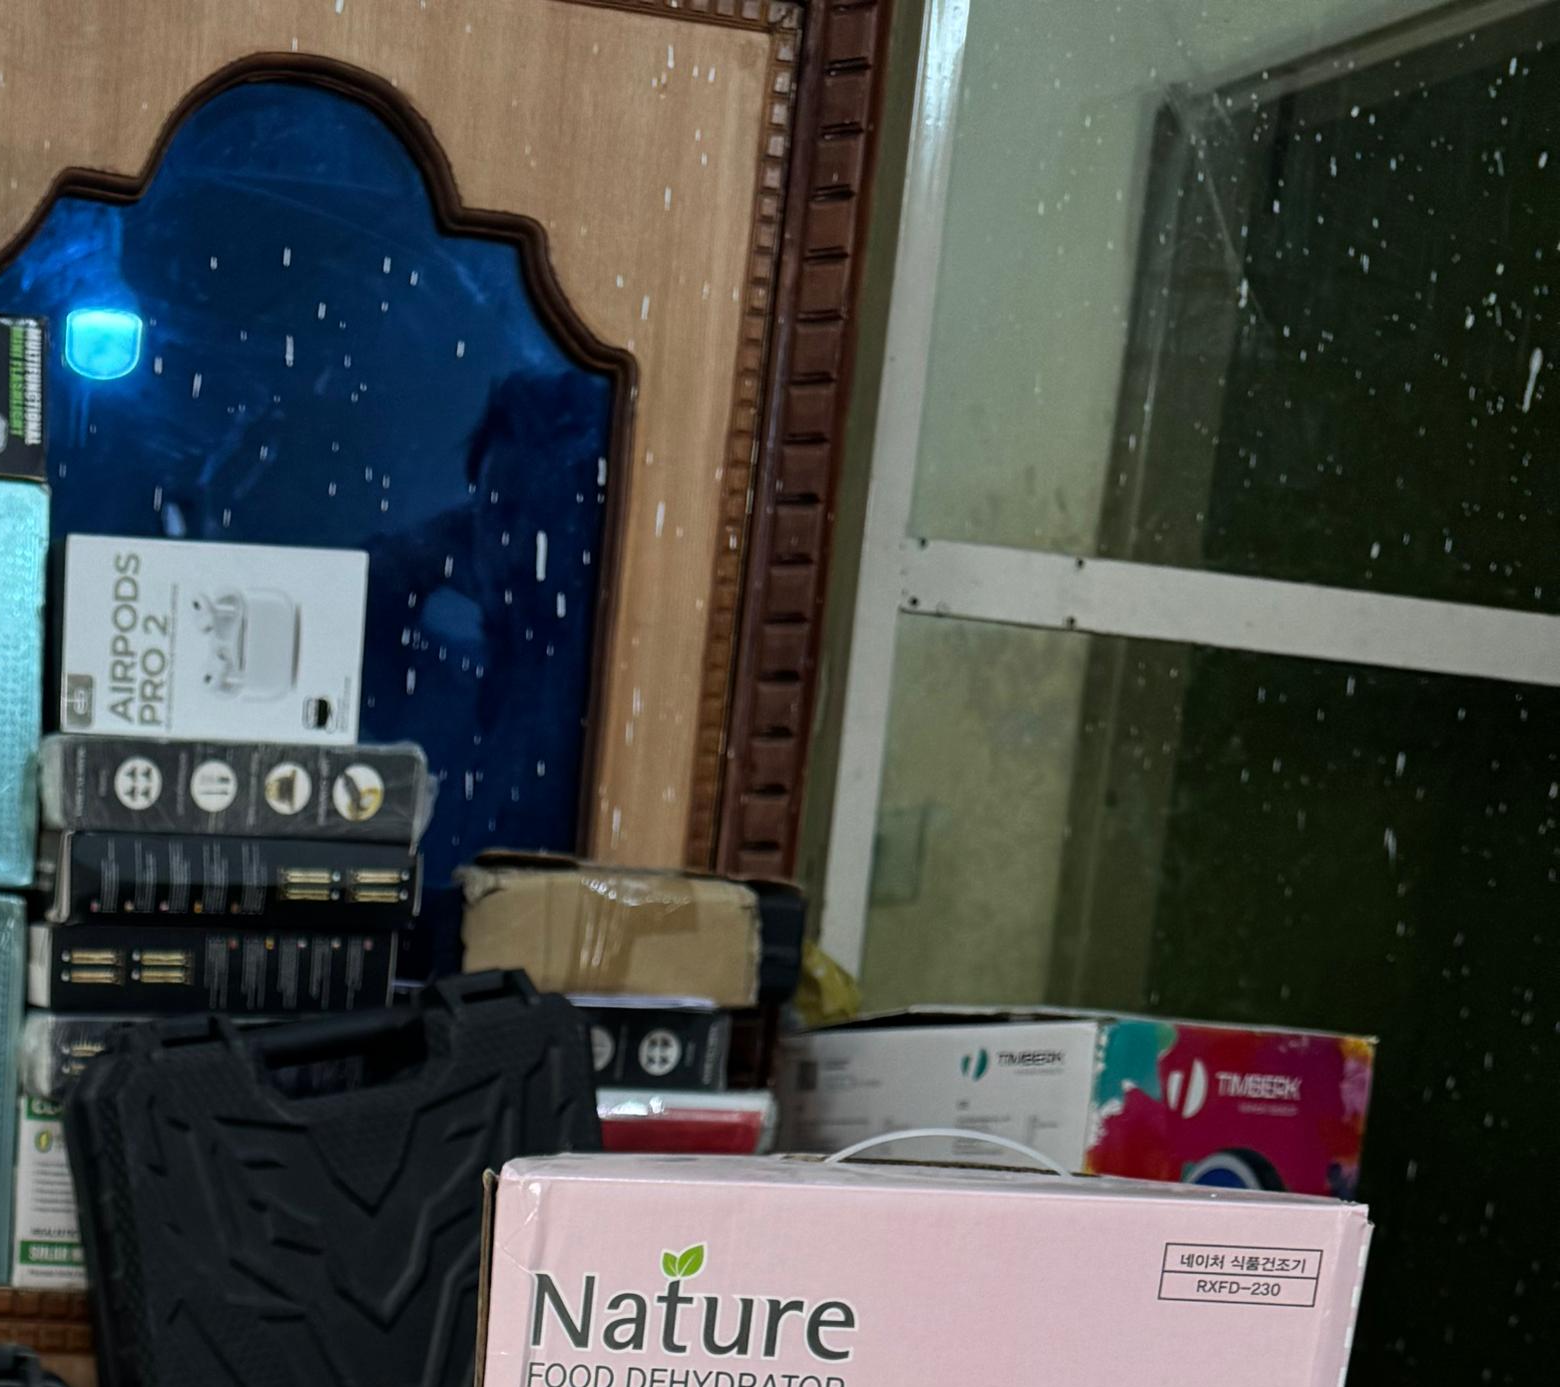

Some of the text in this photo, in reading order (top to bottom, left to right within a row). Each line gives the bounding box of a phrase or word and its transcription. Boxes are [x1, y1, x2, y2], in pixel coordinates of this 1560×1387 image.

[25, 327, 42, 446] MULTIFUNCTIONAL
[108, 551, 141, 724] AIRPODS
[141, 614, 169, 727] PRO 2
[1215, 1071, 1302, 1100] TIMBERK
[1180, 1252, 1307, 1274] 네이처 식품건조기
[1196, 1278, 1281, 1298] RXFD-230
[528, 1273, 857, 1363] Nature
